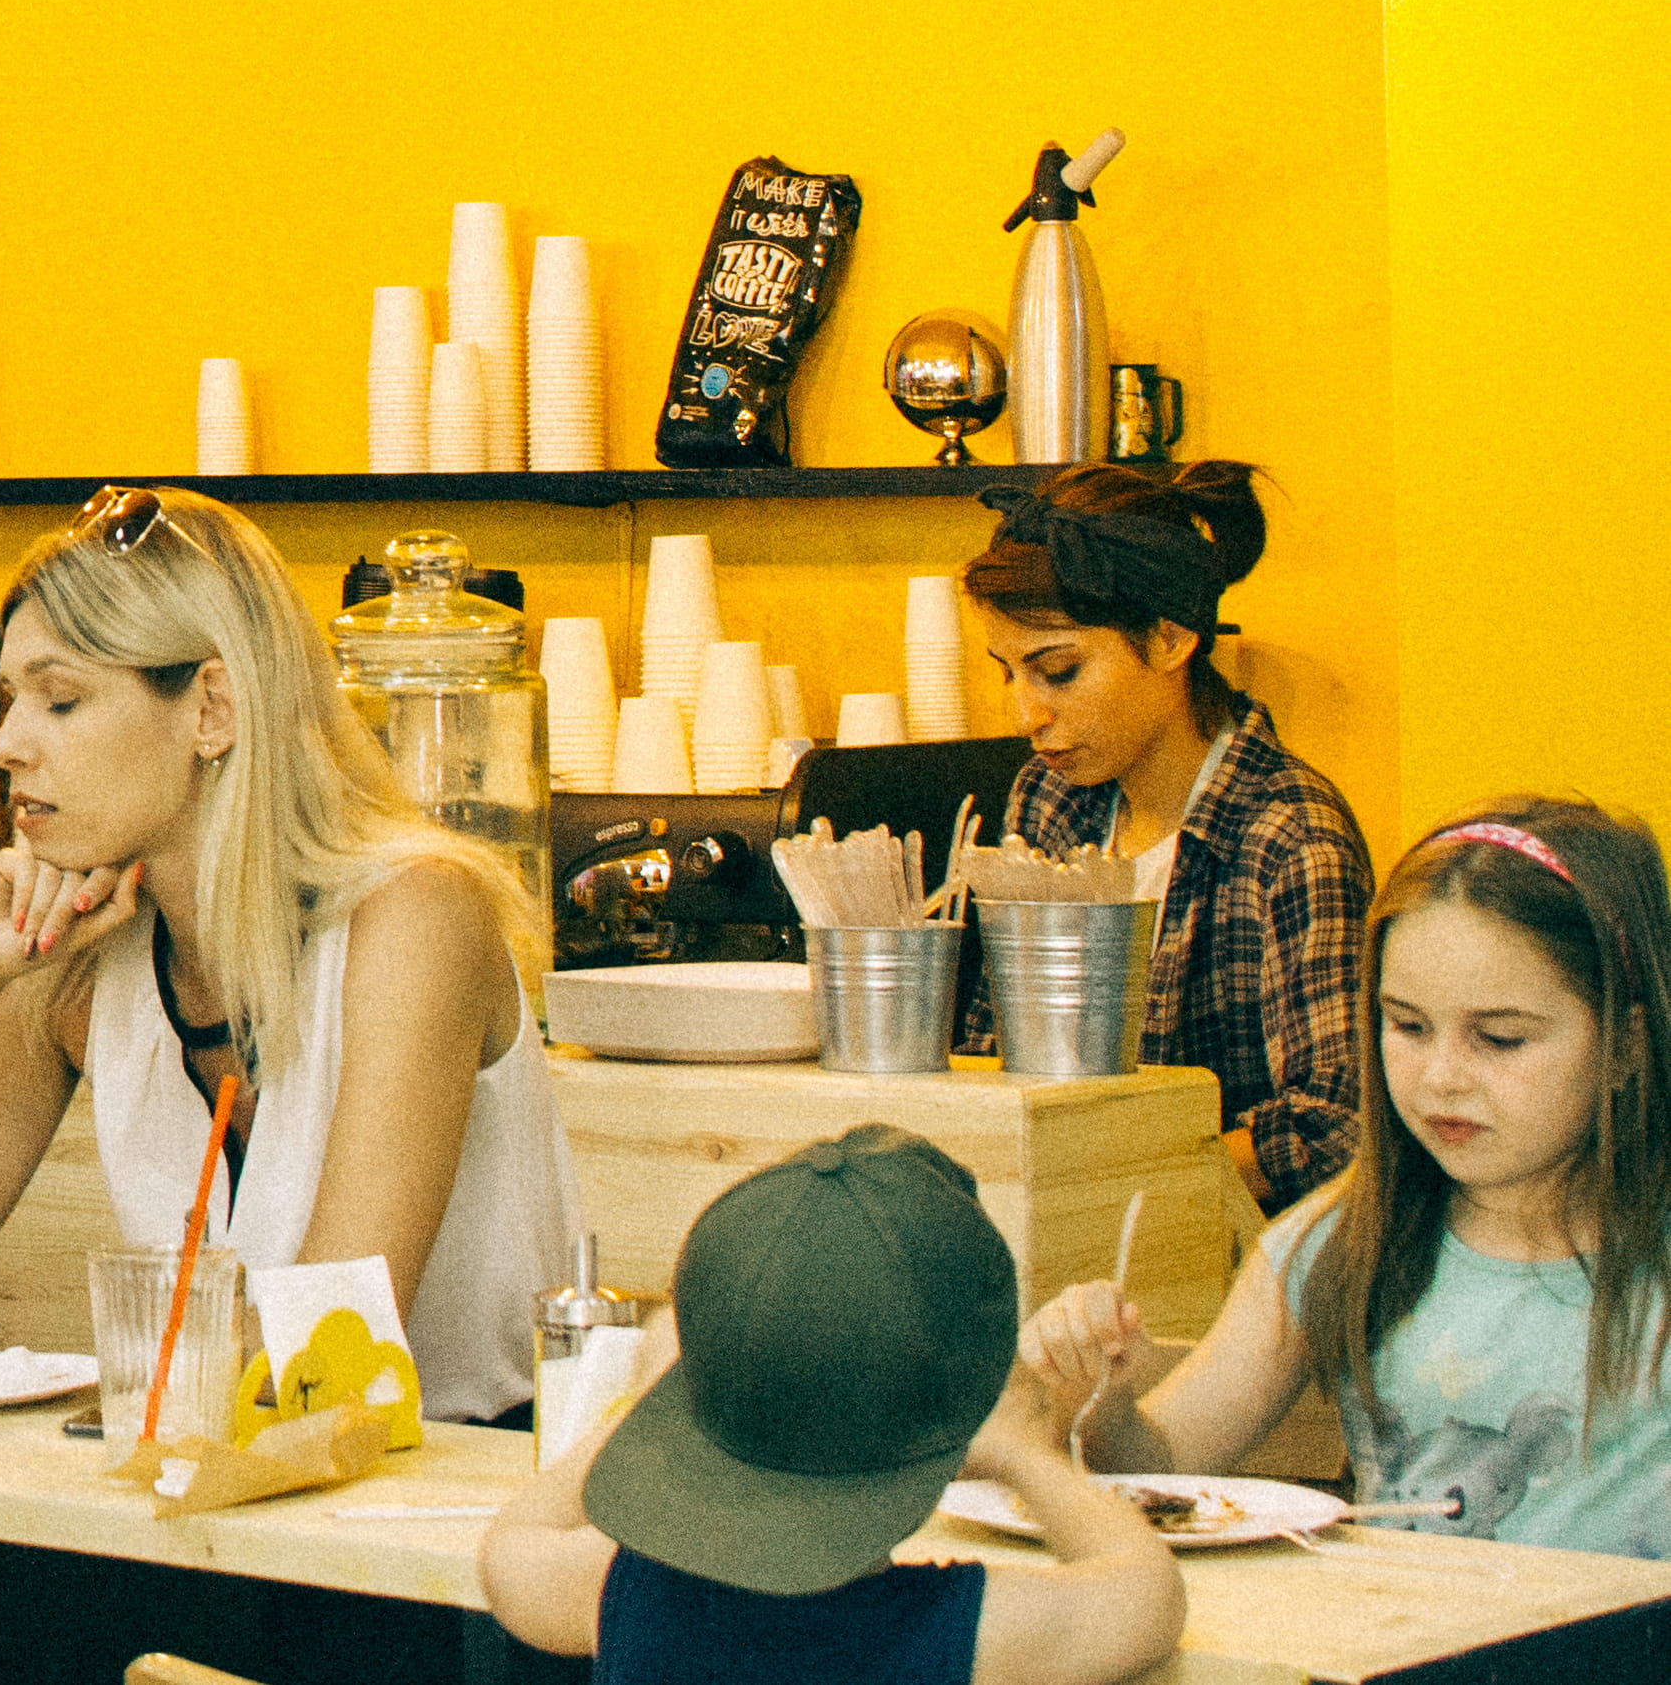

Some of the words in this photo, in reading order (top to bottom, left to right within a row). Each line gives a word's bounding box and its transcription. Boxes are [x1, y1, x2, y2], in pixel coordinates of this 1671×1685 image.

[732, 171, 826, 208] MAKE
[721, 243, 799, 283] TASTY
[714, 271, 786, 306] COFFEE
